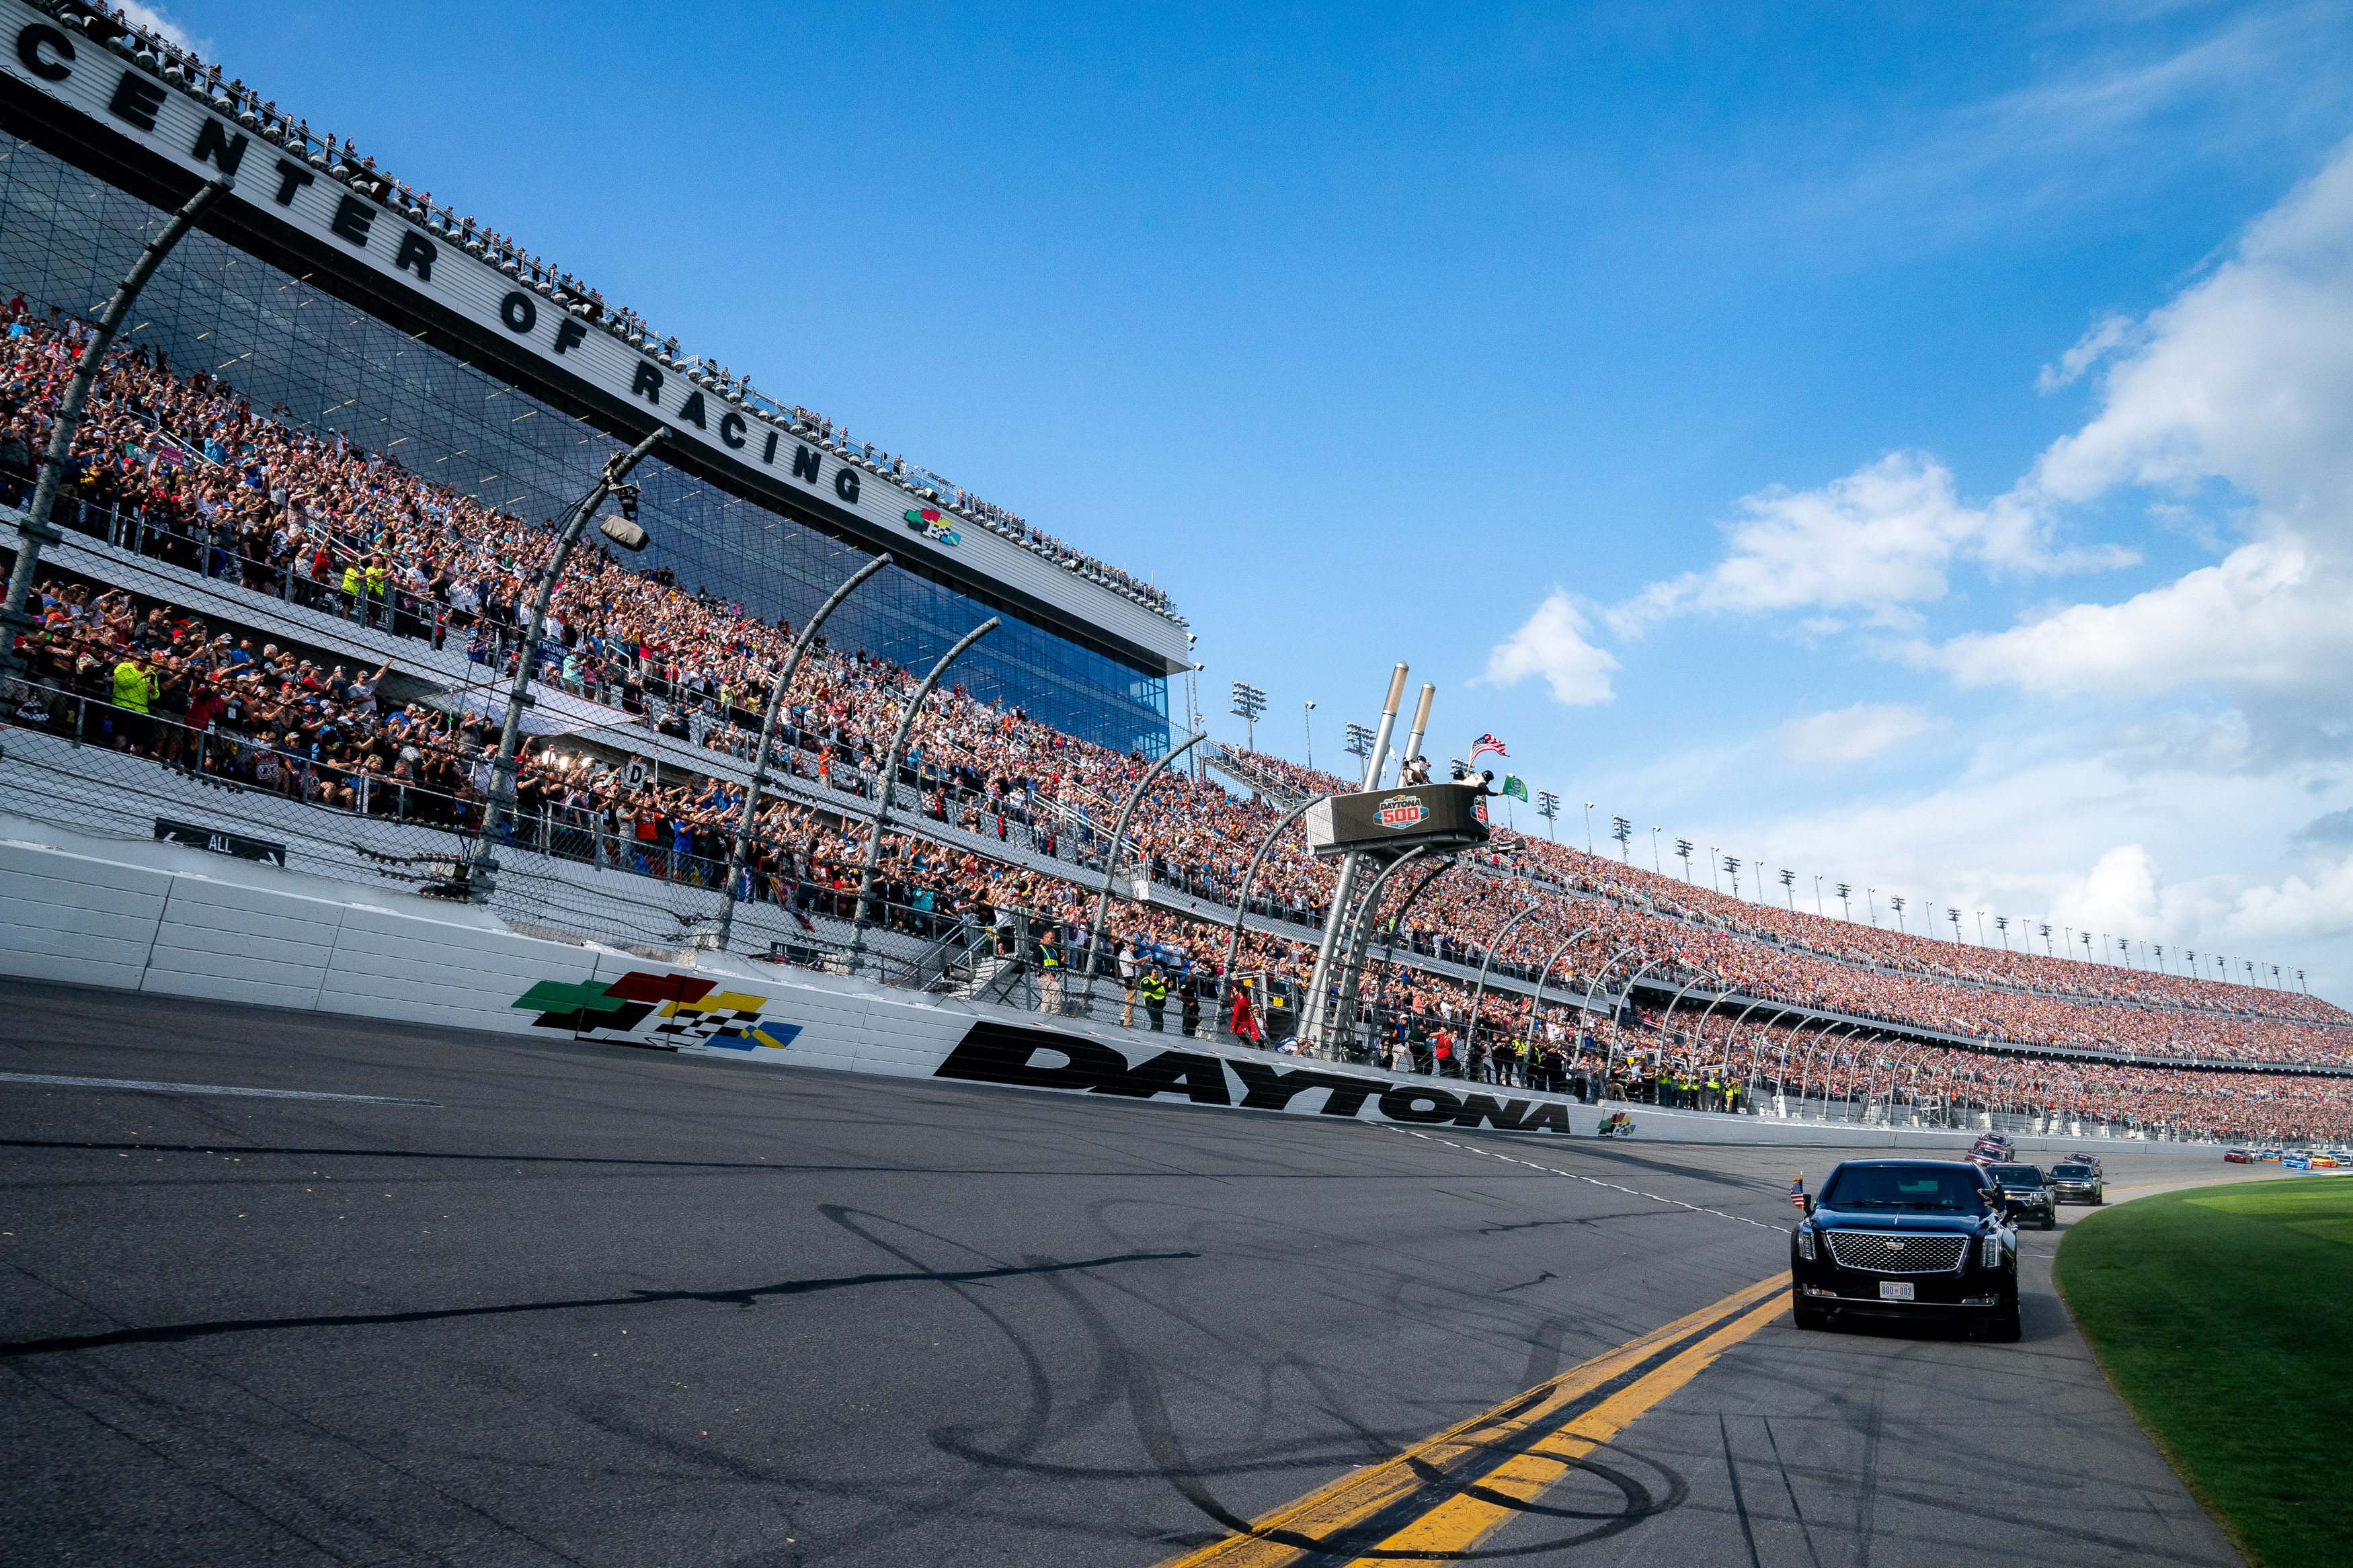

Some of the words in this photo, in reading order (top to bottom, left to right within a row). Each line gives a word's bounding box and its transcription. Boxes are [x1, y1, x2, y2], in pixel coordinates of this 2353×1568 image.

[17, 23, 438, 282] CENTER
[502, 291, 587, 355] OF
[633, 362, 861, 504] RACING
[629, 765, 642, 784] D
[1380, 799, 1421, 810] DAYTONA
[1383, 807, 1419, 823] 500
[208, 834, 232, 854] ALL
[933, 1020, 1570, 1134] DAYTONA
[1882, 1286, 1893, 1294] 800
[1900, 1286, 1911, 1296] 002
